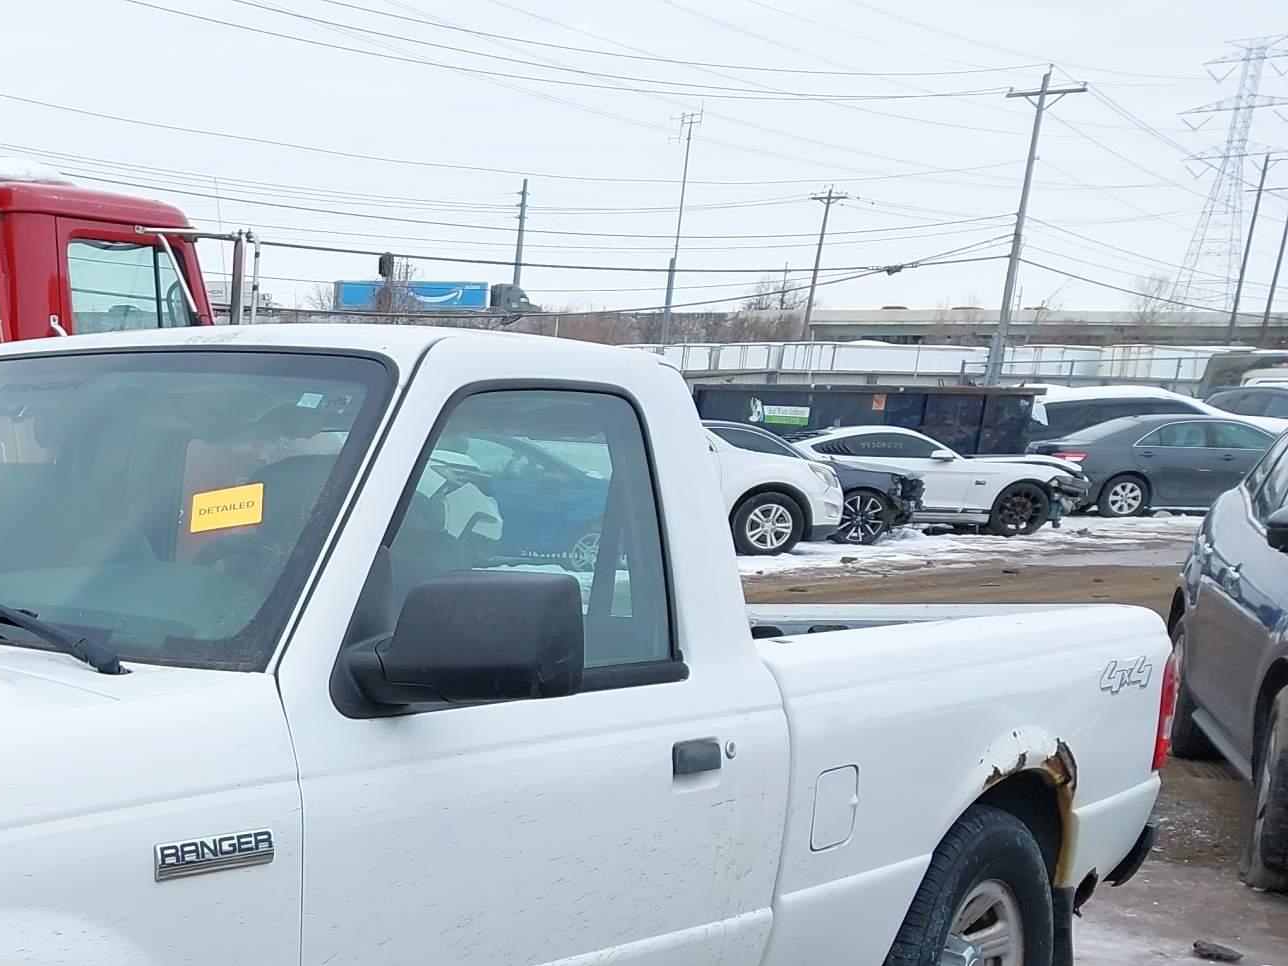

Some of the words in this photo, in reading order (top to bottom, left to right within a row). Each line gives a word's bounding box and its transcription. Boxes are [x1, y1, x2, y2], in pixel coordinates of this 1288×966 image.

[198, 501, 255, 517] DETAILED
[1100, 656, 1152, 695] 4x4
[159, 831, 273, 865] RANGER
